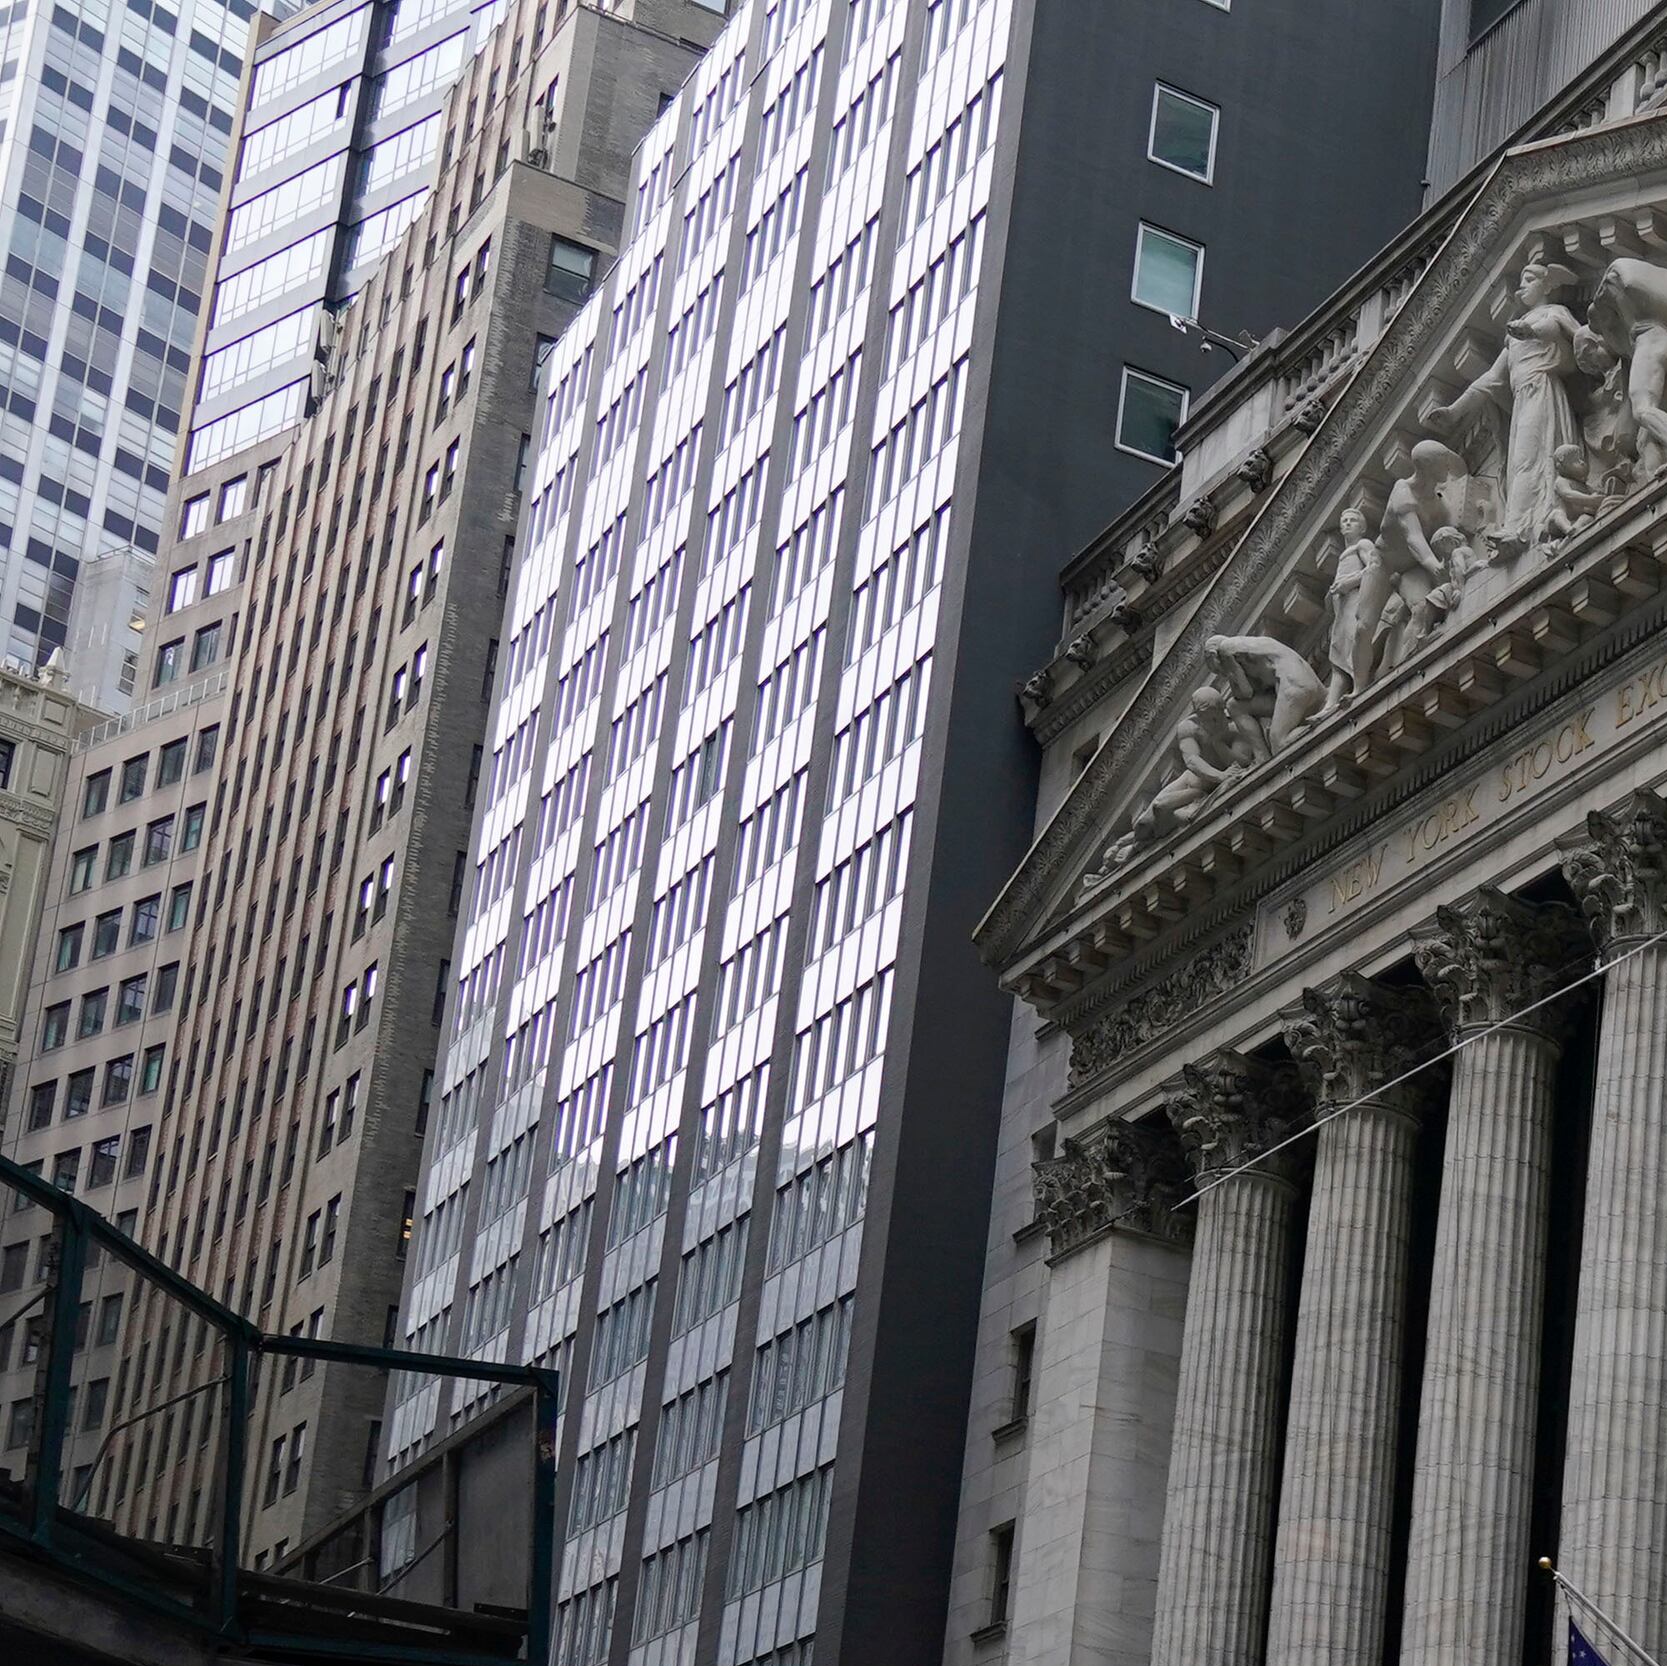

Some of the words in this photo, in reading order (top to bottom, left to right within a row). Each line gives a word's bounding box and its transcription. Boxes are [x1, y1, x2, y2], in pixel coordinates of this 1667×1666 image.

[1328, 844, 1388, 913] NEW
[1403, 783, 1480, 863] YORK
[1499, 706, 1595, 801] STOCK
